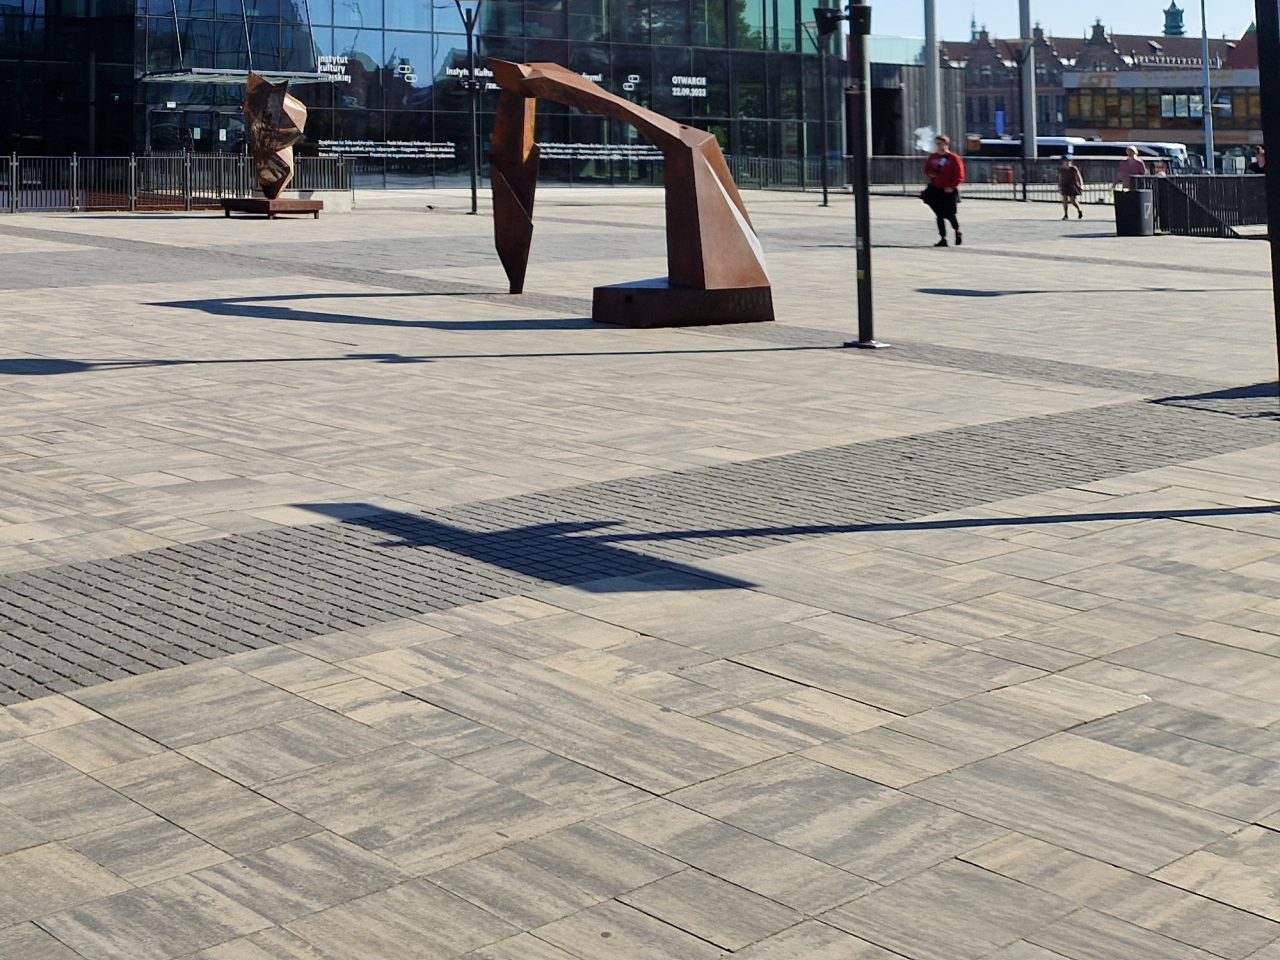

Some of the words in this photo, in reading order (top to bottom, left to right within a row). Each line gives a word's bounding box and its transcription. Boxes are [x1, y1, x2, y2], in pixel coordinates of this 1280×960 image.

[318, 55, 349, 65] Instytut
[318, 63, 346, 74] kultury
[672, 76, 707, 86] OTWARCIE
